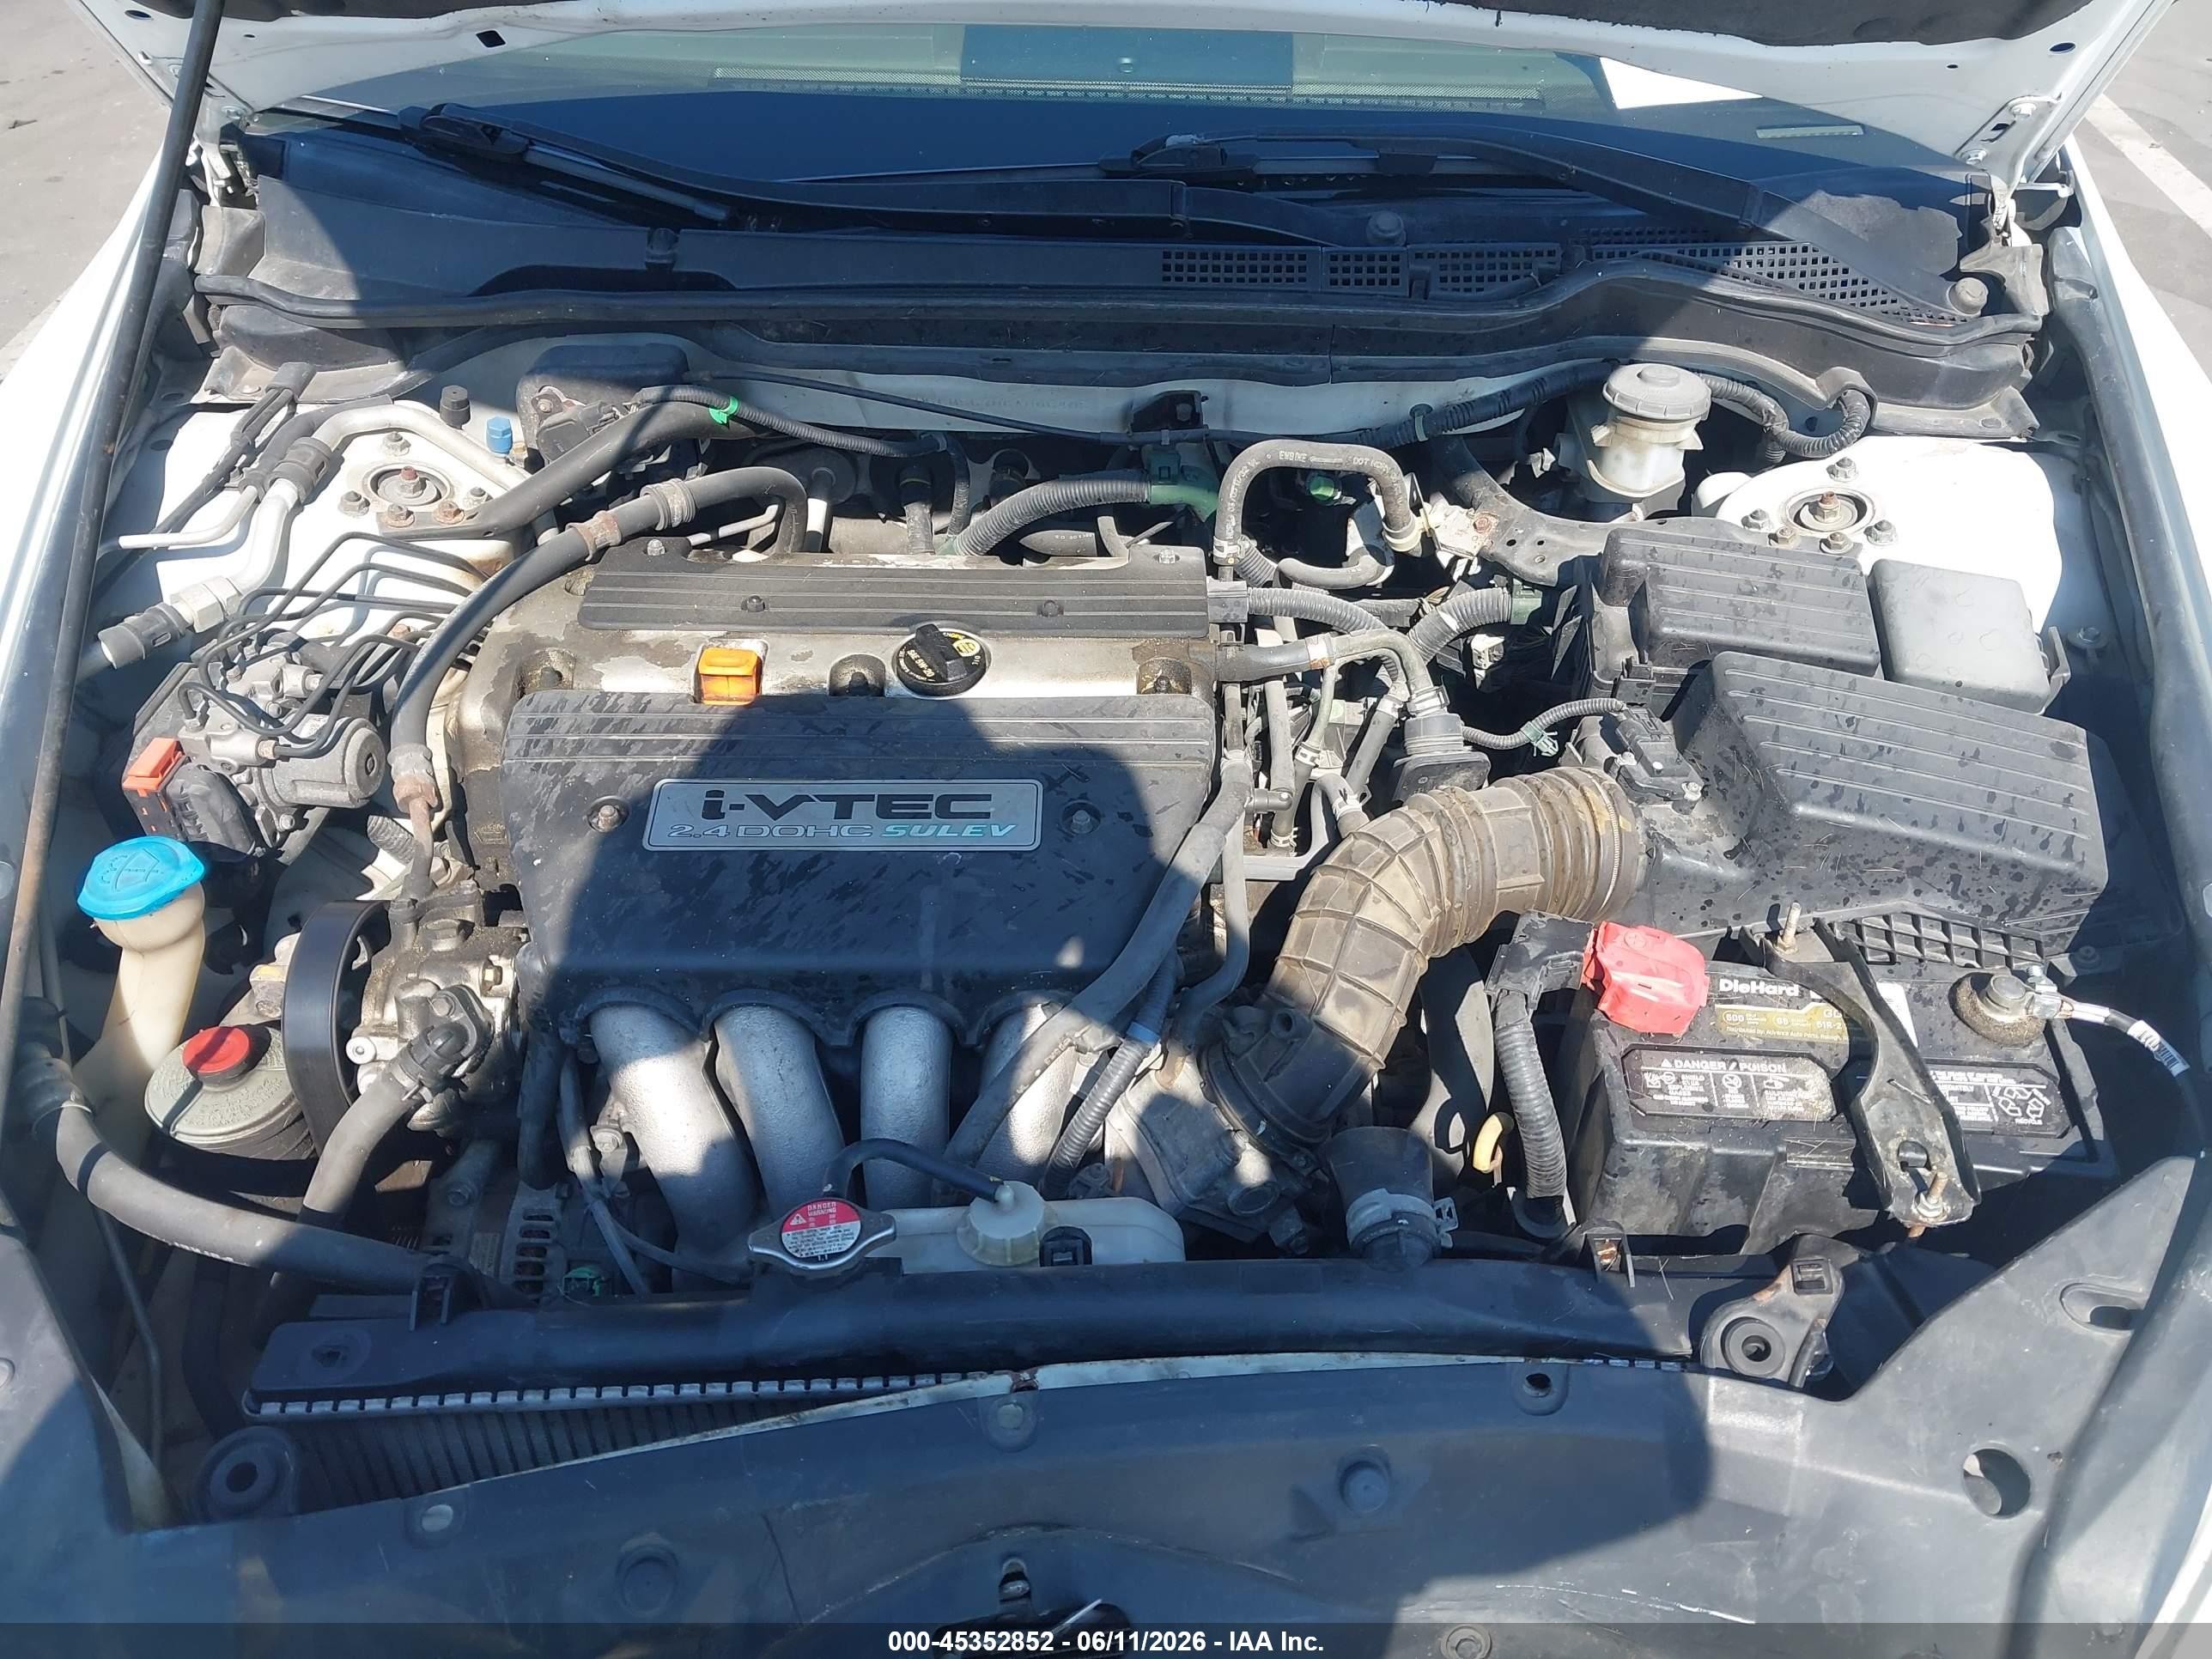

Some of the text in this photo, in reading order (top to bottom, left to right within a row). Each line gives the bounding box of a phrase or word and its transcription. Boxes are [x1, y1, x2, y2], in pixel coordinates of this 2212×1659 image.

[906, 649, 921, 662] SAE
[915, 658, 935, 678] 5W-20
[701, 789, 993, 822] i-VTEC
[667, 823, 1018, 839] 2.4 DOHC SULEV
[1718, 978, 1800, 997] DieHard
[1674, 1059, 1727, 1071] DANGER
[1739, 1062, 1787, 1073] POISON
